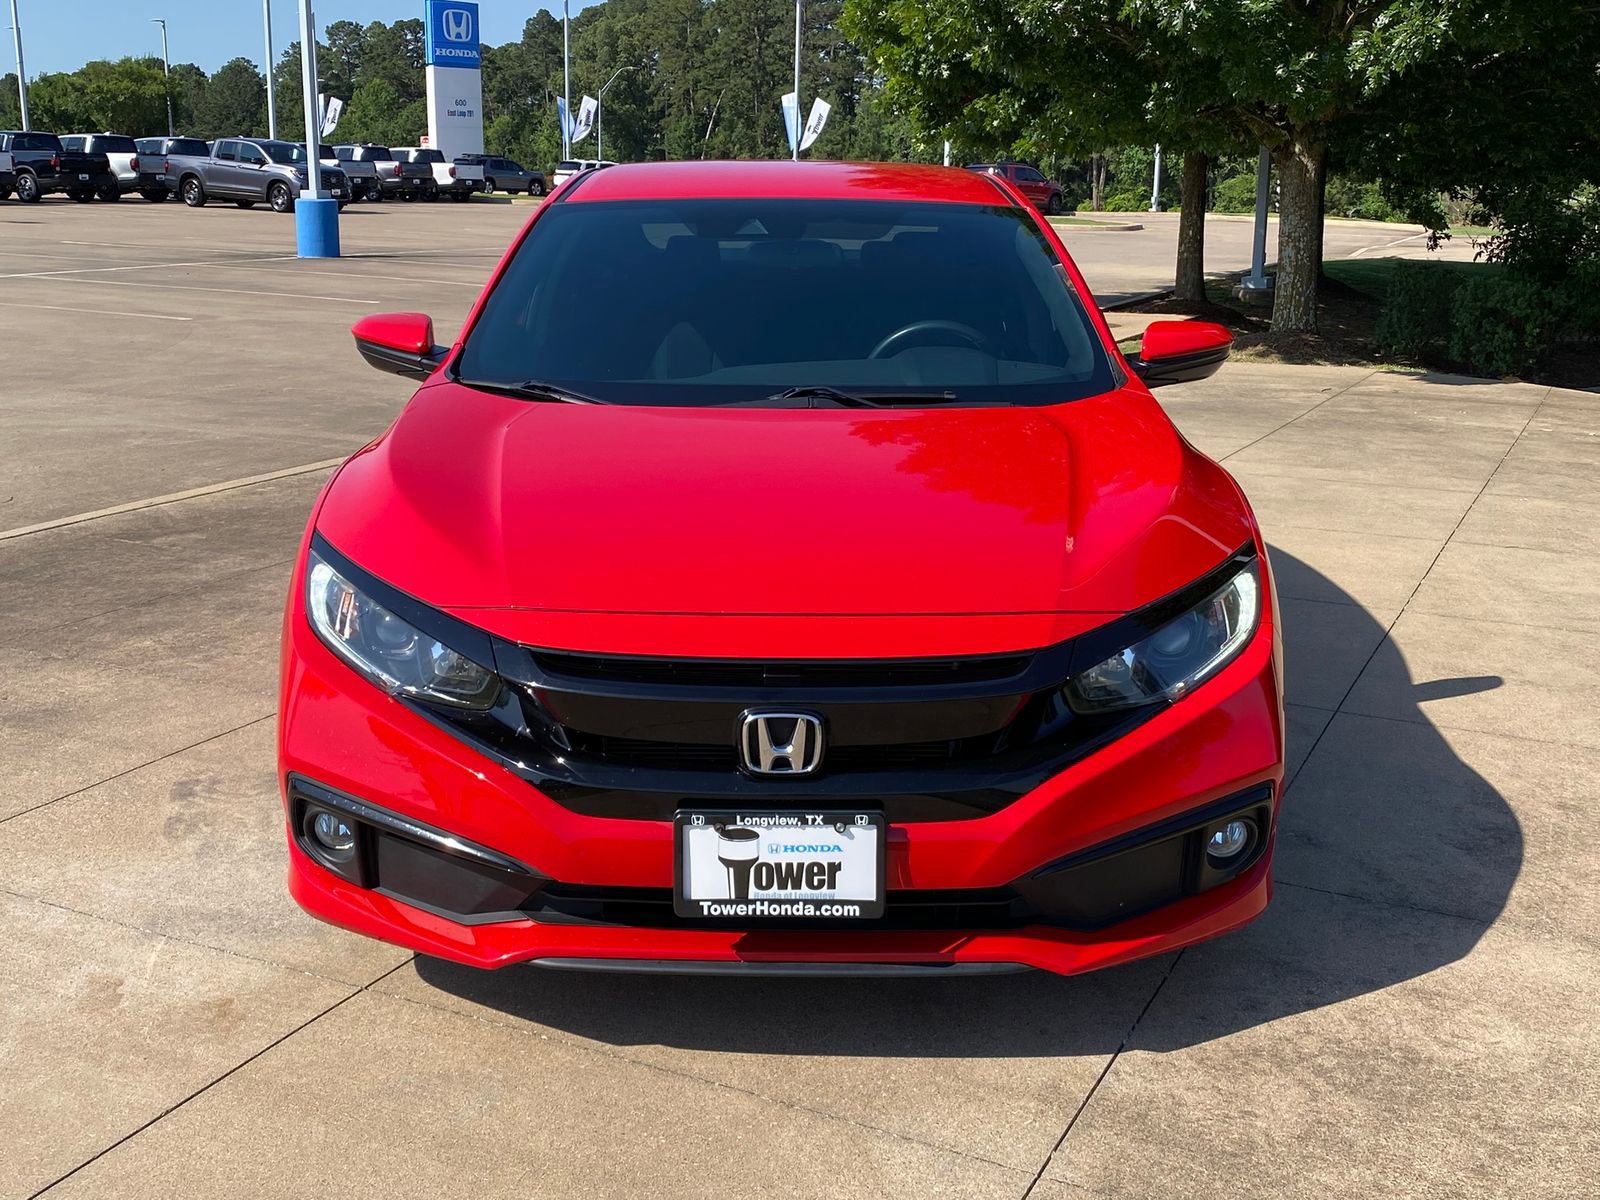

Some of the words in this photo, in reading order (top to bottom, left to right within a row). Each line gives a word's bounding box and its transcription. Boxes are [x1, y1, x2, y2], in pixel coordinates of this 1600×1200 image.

[435, 47, 479, 58] HONDA
[454, 99, 467, 107] 600
[811, 113, 824, 135] Tower
[736, 815, 802, 826] Longview,
[805, 815, 824, 825] TX
[783, 844, 843, 853] HONDA
[718, 828, 842, 899] Tower
[700, 901, 860, 917] TowerHonda.com
